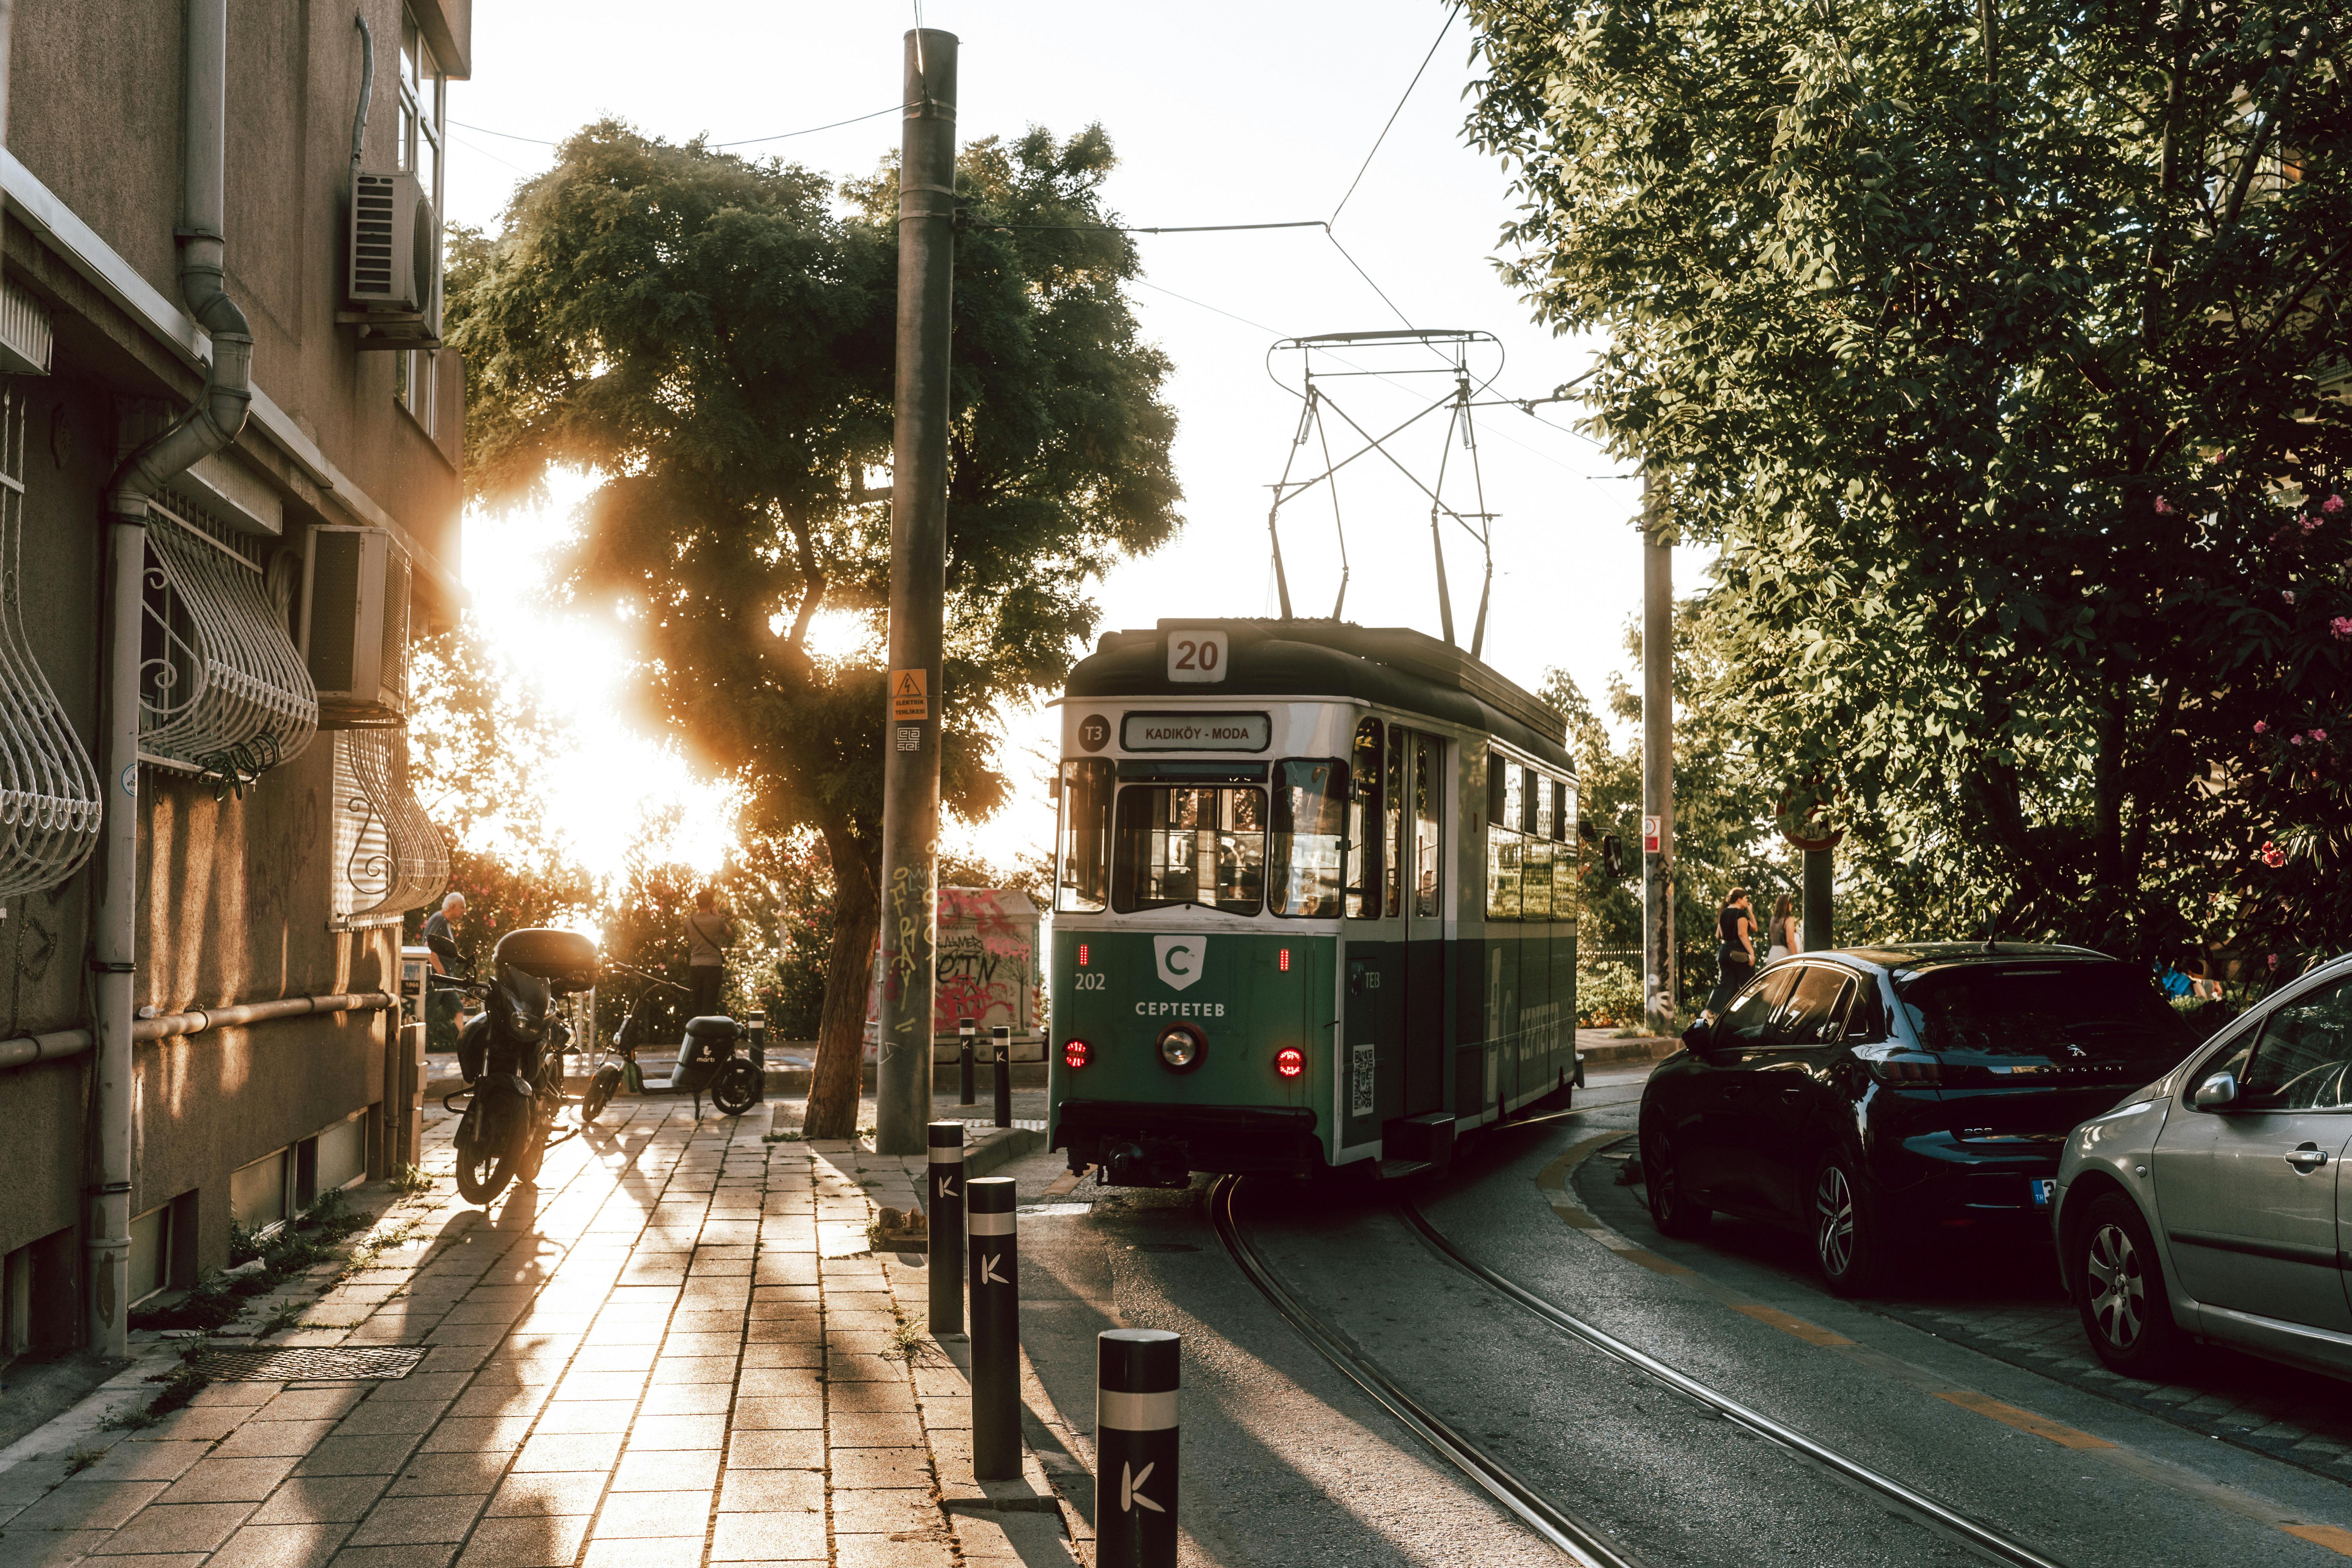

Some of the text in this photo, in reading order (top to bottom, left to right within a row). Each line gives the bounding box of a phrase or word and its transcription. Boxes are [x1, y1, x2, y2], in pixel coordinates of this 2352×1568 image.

[1175, 641, 1218, 671] 20
[1085, 726, 1102, 740] T3
[1146, 726, 1201, 739] KADIKÖY
[1212, 728, 1249, 739] MODA
[1165, 945, 1190, 975] C
[1075, 973, 1105, 990] 202
[1365, 972, 1380, 988] TEB
[1135, 1002, 1225, 1017] CEPTETEB
[1519, 1002, 1559, 1062] CEPTETEB
[996, 1051, 1006, 1062] K
[939, 1175, 958, 1198] K
[981, 1253, 1009, 1285] K
[1120, 1460, 1166, 1512] K
